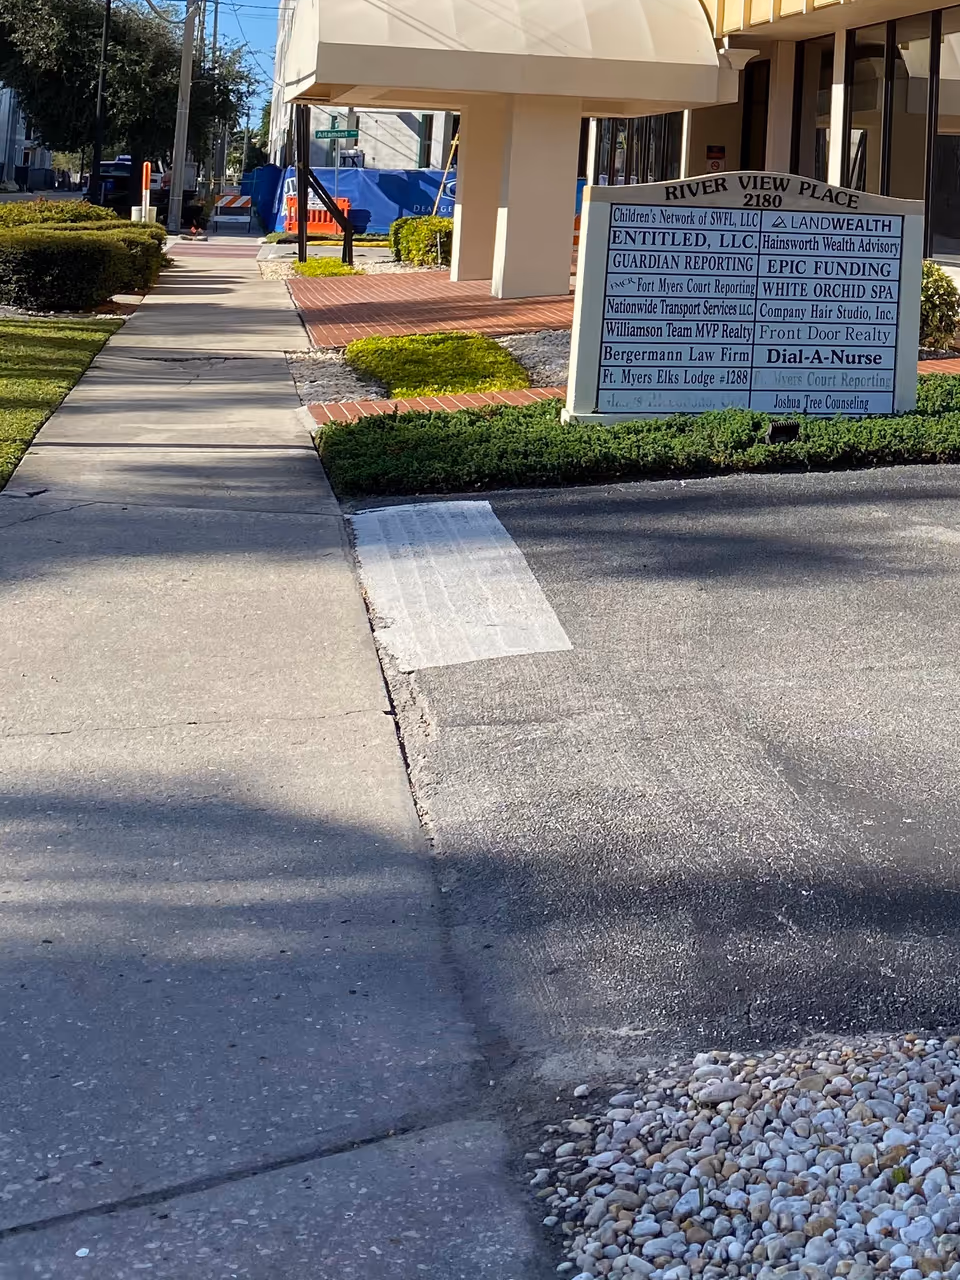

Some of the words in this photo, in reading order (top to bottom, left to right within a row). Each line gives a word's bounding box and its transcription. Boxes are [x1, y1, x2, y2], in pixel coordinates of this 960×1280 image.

[665, 177, 728, 201] RIVER
[738, 176, 791, 192] VIEW
[798, 181, 859, 209] PLACE
[743, 193, 782, 208] 2180
[613, 207, 656, 223] Children's
[659, 209, 695, 224] Network
[699, 211, 707, 225] of
[710, 211, 737, 228] SWFL,
[740, 213, 758, 227] LLC
[791, 216, 892, 232] LANDWEALTH
[611, 230, 711, 249] ENTITLED,
[719, 233, 757, 249] LLC.
[762, 234, 819, 251] Hainsworth
[823, 236, 855, 252] Wealth
[857, 237, 899, 256] Advisory
[613, 253, 680, 270] GUARDIAN
[684, 255, 753, 271] REPORTING
[767, 259, 806, 274] EPIC
[813, 261, 892, 277] FUNDING
[636, 277, 654, 292] Fort
[658, 278, 683, 295] Myers
[687, 278, 710, 293] Court
[714, 279, 756, 296] Reporting
[762, 282, 808, 297] WHITE
[813, 283, 866, 299] ORCHID
[870, 284, 893, 299] SPA
[607, 298, 657, 314] Nationwide
[660, 299, 701, 317] Transport
[703, 300, 737, 315] Services
[739, 304, 754, 316] LLC.
[760, 303, 806, 320] Company
[810, 304, 833, 319] Hair
[836, 305, 871, 321] Studio,
[875, 306, 894, 320] Inc.
[606, 321, 662, 338] Williamson
[666, 323, 692, 337] Team
[695, 323, 719, 338] MVP
[721, 323, 753, 342] Realty
[759, 325, 802, 340] Front
[807, 326, 841, 340] Door
[845, 326, 891, 344] Realty
[603, 345, 682, 364] Bergermann
[688, 347, 715, 361] Law
[720, 347, 750, 362] Firm
[766, 348, 882, 365] Dial-A-Nurse
[602, 368, 616, 383] Ft.
[621, 369, 652, 386] Myers
[656, 369, 679, 384] Elks
[683, 369, 715, 387] Lodge
[719, 370, 748, 385] #1288
[807, 371, 836, 387] Court
[841, 372, 891, 389] Reporting
[773, 393, 800, 409] Joshua
[804, 394, 822, 409] Tree
[825, 394, 869, 412] Counseling
